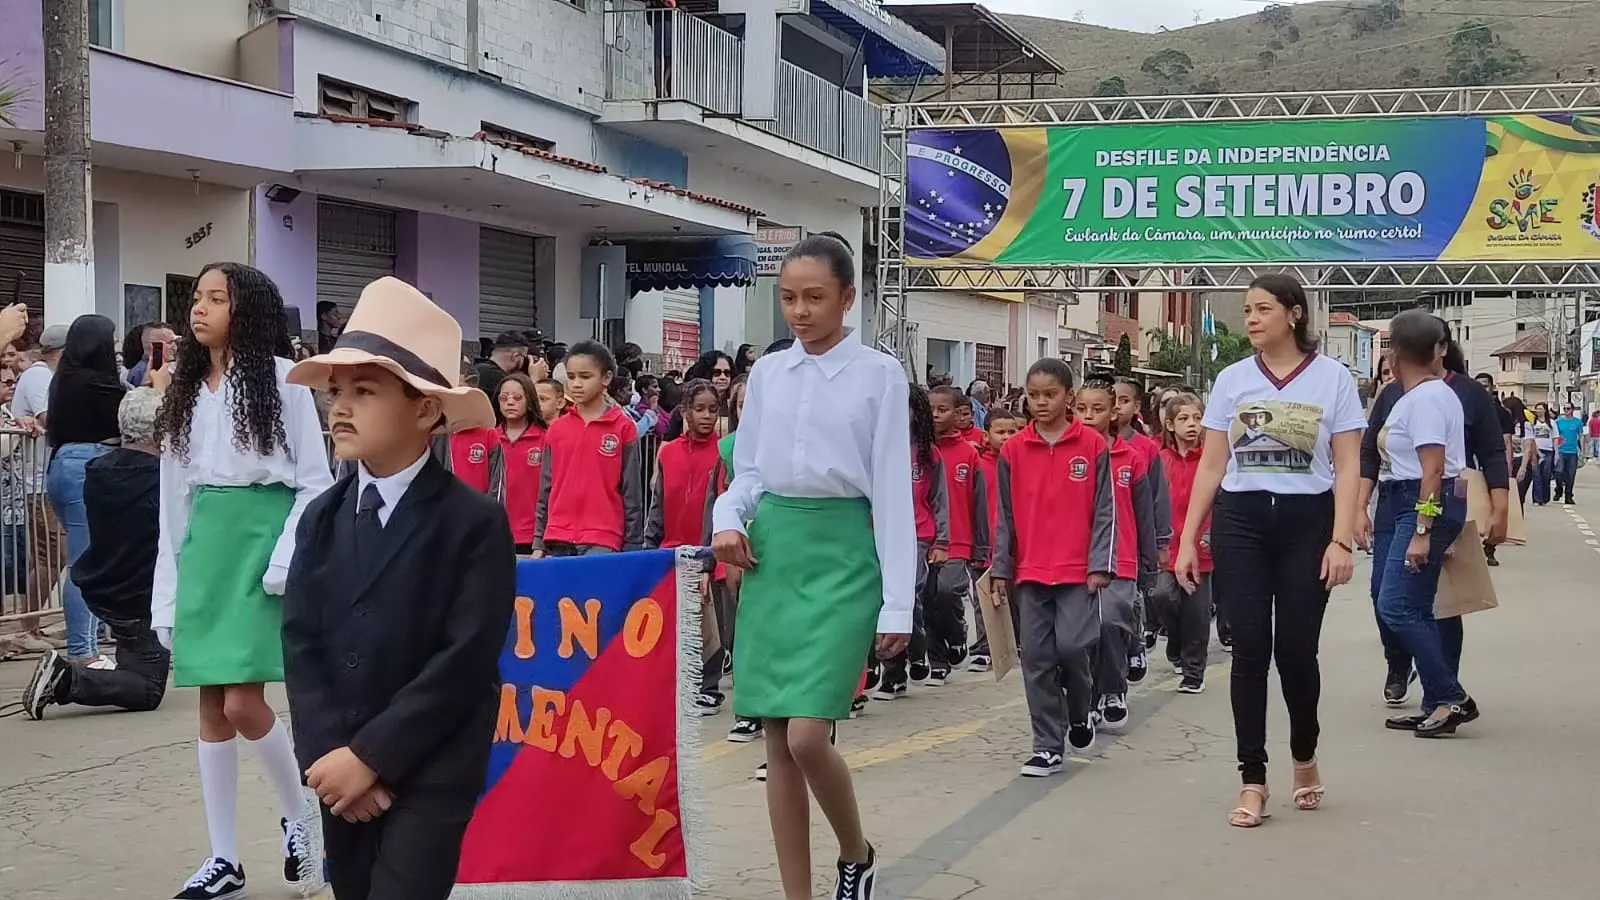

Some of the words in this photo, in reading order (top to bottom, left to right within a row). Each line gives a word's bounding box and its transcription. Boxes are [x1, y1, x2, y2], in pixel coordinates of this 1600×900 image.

[918, 147, 926, 156] E
[934, 152, 1007, 194] PROGRESSO
[1096, 150, 1179, 167] DESFILE
[1184, 149, 1212, 165] DA
[1218, 141, 1391, 164] INDEPENDÊNCIA
[1062, 178, 1087, 220] 7
[1103, 176, 1159, 219] DE
[1175, 171, 1426, 218] SETEMBRO
[1064, 227, 1120, 242] Ewbank
[1122, 226, 1142, 241] da
[1144, 226, 1206, 241] Câmara,
[1209, 229, 1235, 240] um
[1237, 225, 1313, 244] município
[1314, 229, 1335, 240] no
[1337, 227, 1379, 240] rumo
[1380, 222, 1423, 240] certo!
[643, 262, 688, 273] MUNDIAL
[514, 597, 664, 659] INO
